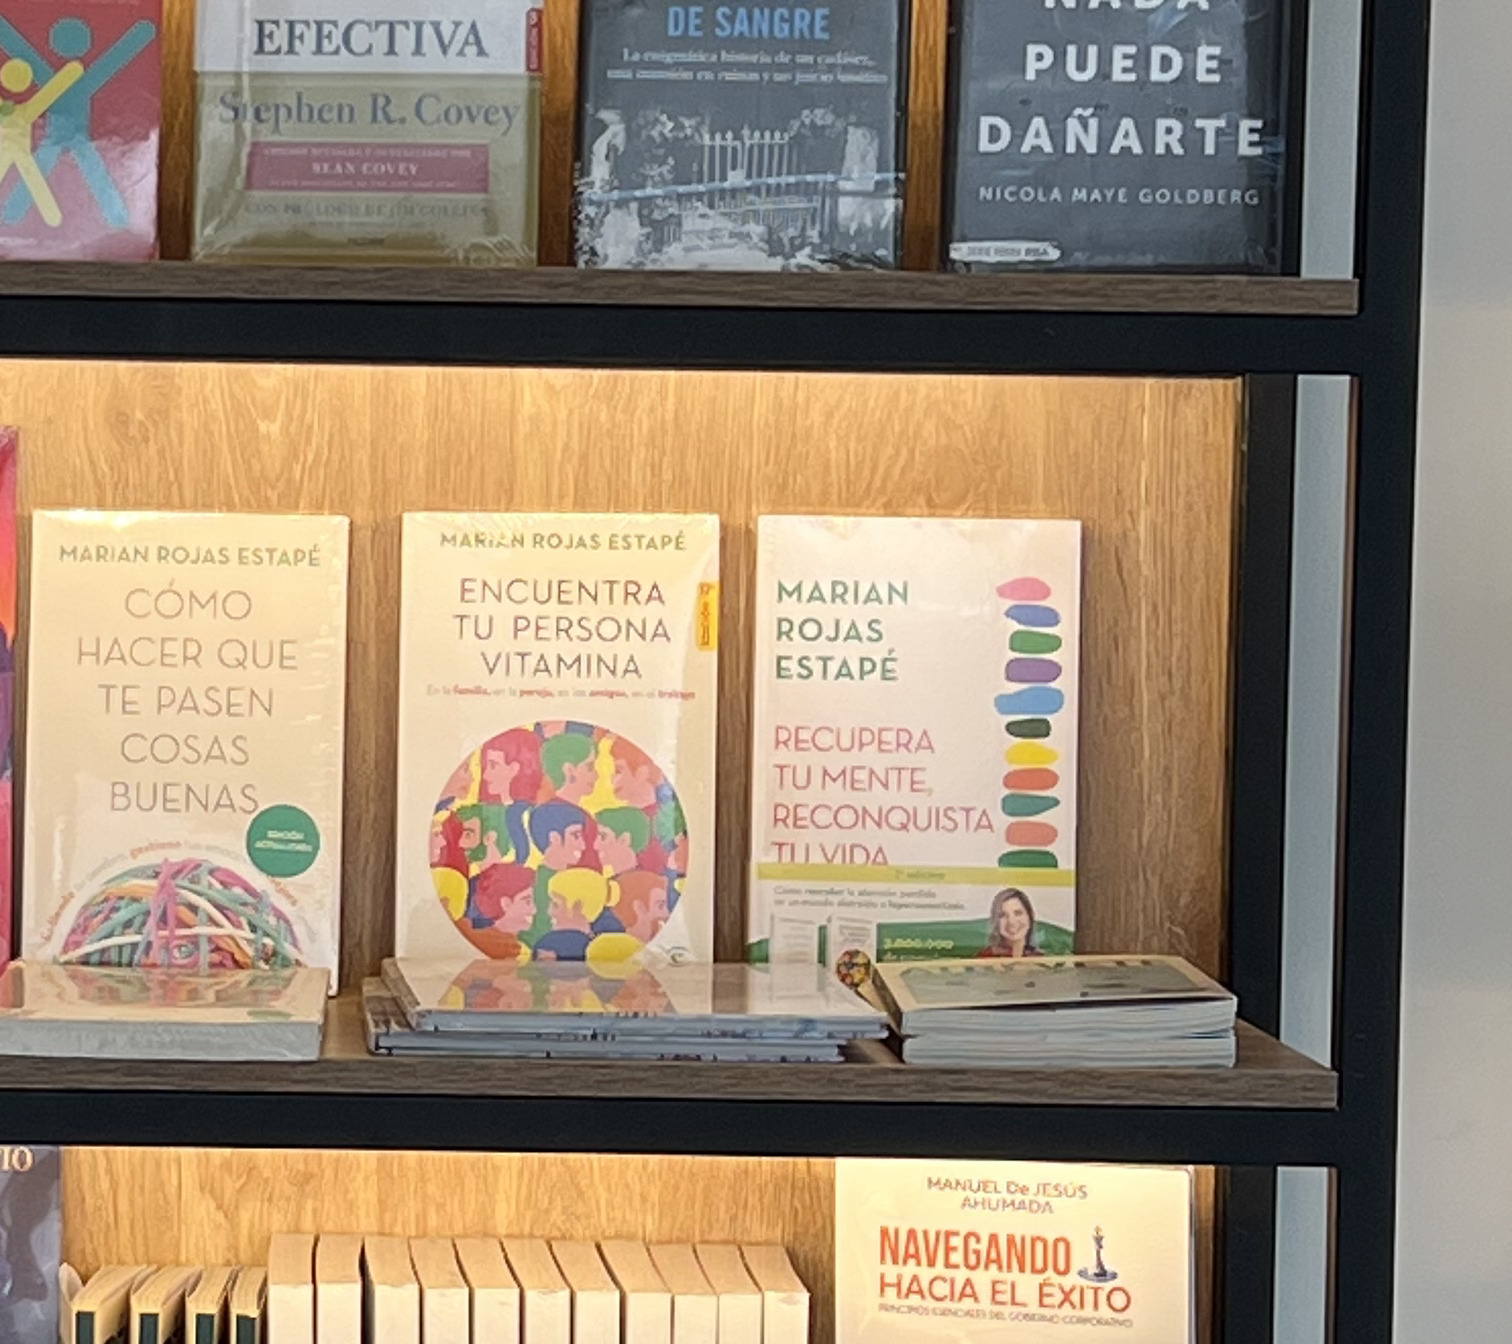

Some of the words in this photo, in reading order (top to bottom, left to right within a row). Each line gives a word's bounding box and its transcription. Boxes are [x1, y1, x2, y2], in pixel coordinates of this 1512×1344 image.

[253, 20, 489, 58] EFECTIVA
[668, 8, 704, 37] DE
[715, 8, 830, 40] SANGRE
[1024, 43, 1222, 83] PUEDE
[219, 91, 357, 136] Stephen
[369, 94, 406, 125] R.
[415, 93, 522, 136] Covey
[977, 107, 1264, 156] DAÑARTE
[979, 185, 1062, 202] NICOLA
[1071, 186, 1128, 204] MAYE
[1139, 186, 1259, 206] GOLDBERG
[59, 545, 149, 564] MARIAN
[157, 546, 230, 566] ROJAS
[238, 543, 321, 568] ESTAPÉ
[440, 532, 525, 550] MARIAN
[532, 533, 601, 551] ROJAS
[608, 529, 687, 551] ESTAPÉ
[124, 577, 252, 622] CÓMO
[459, 577, 666, 606] ENCUENTRA
[776, 579, 909, 606] MARIAN
[452, 613, 495, 641] TU
[513, 615, 671, 643] PERSONA
[776, 618, 884, 643] ROJAS
[76, 636, 202, 668] HACER
[218, 637, 298, 672] QUE
[479, 651, 642, 680] VITAMINA
[776, 647, 899, 681] ESTAPÉ
[98, 683, 140, 715] TE
[157, 685, 273, 718] PASEN
[120, 732, 250, 767] COSAS
[774, 724, 935, 755] RECUPERA
[773, 764, 812, 791] TU
[821, 766, 934, 796] MENTE,
[110, 781, 259, 816] BUENAS
[772, 803, 995, 833] RECONQUISTA
[772, 841, 809, 865] TU
[818, 843, 890, 867] VIDA
[927, 1176, 1001, 1194] MANUEL
[1006, 1181, 1030, 1196] De
[1033, 1181, 1088, 1200] JESÚS
[960, 1196, 1054, 1214] AHUMADA
[879, 1225, 1072, 1277] NAVEGANDO
[879, 1272, 980, 1304] HACIA
[991, 1279, 1028, 1308] EL
[1038, 1277, 1133, 1314] ÉXITO
